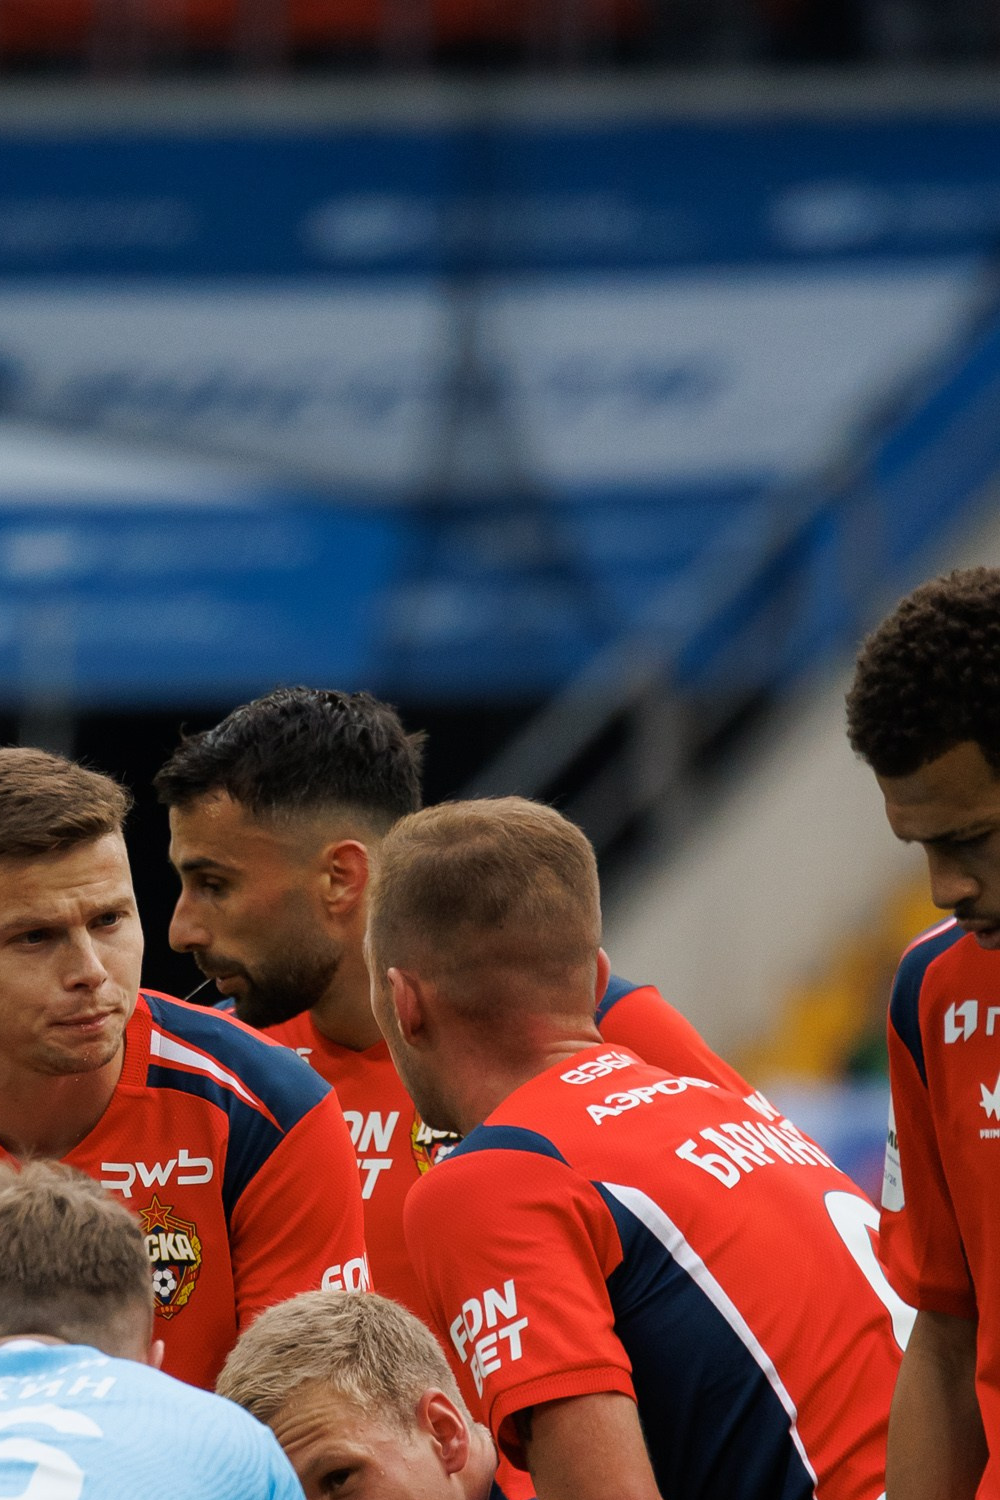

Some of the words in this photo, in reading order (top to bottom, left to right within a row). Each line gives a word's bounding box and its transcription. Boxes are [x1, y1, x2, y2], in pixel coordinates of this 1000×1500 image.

[343, 1111, 399, 1151] ON
[144, 1232, 197, 1262] СКА
[450, 1279, 518, 1363] FON
[470, 1317, 528, 1399] BET
